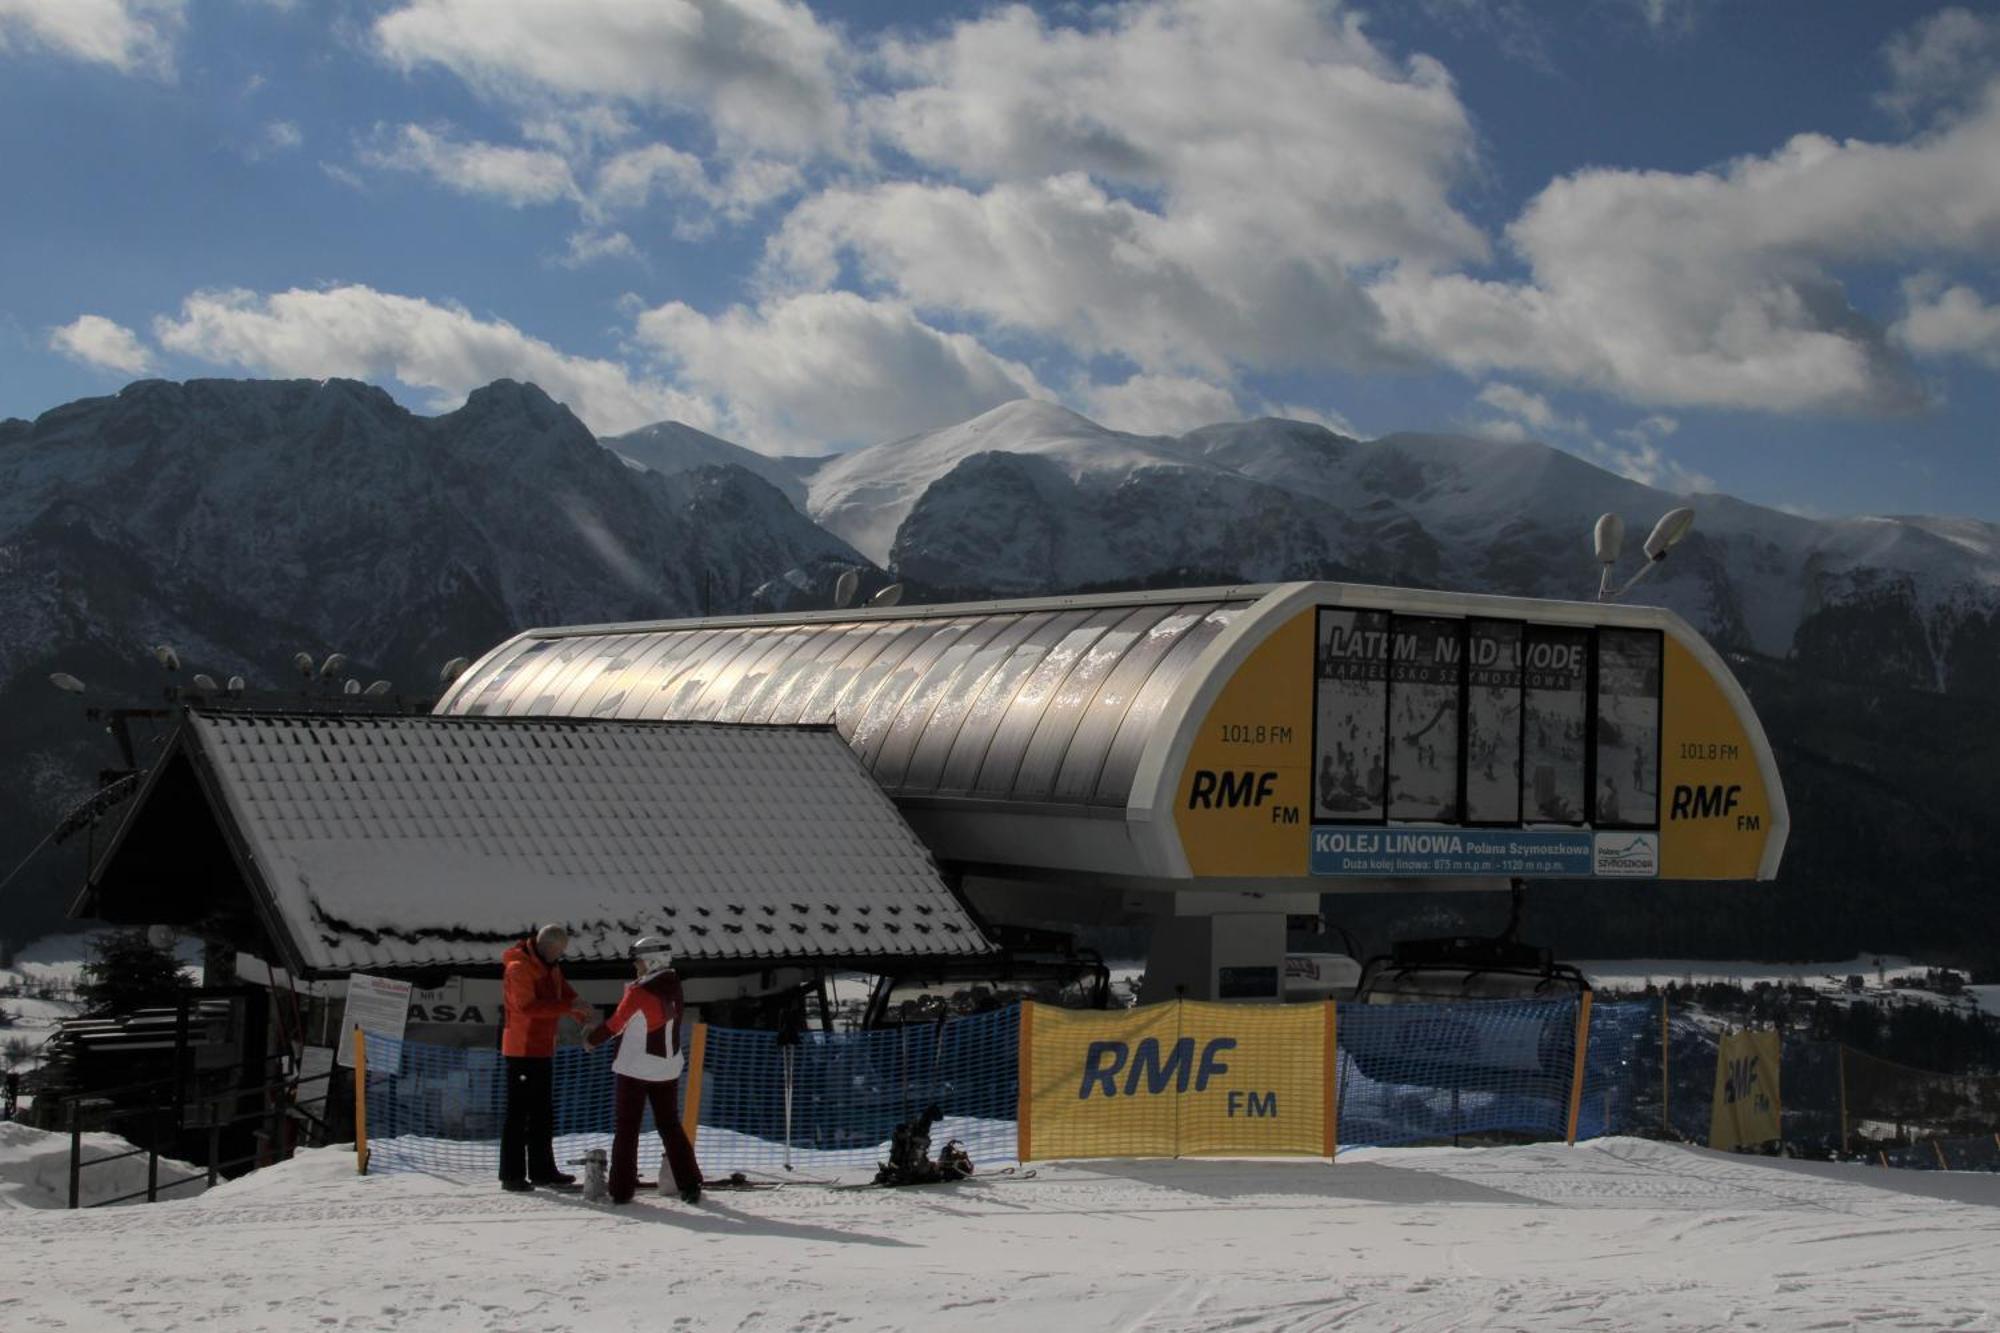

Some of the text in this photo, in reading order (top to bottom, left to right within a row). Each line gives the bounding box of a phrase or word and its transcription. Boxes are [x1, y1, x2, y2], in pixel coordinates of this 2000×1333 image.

[1330, 628, 1418, 662] LATEM
[1434, 635, 1497, 665] NAD
[1270, 726, 1292, 744] FM
[1720, 744, 1739, 760] FM
[1188, 770, 1278, 810] RMF
[1670, 784, 1741, 820] RMF
[1271, 805, 1299, 825] FM
[1737, 815, 1760, 831] FM
[1315, 833, 1380, 853] KOLEJ
[1385, 834, 1463, 854] LINOWA
[1370, 859, 1394, 872] kolej
[1079, 1037, 1237, 1100] RMF
[1227, 1091, 1277, 1118] FM
